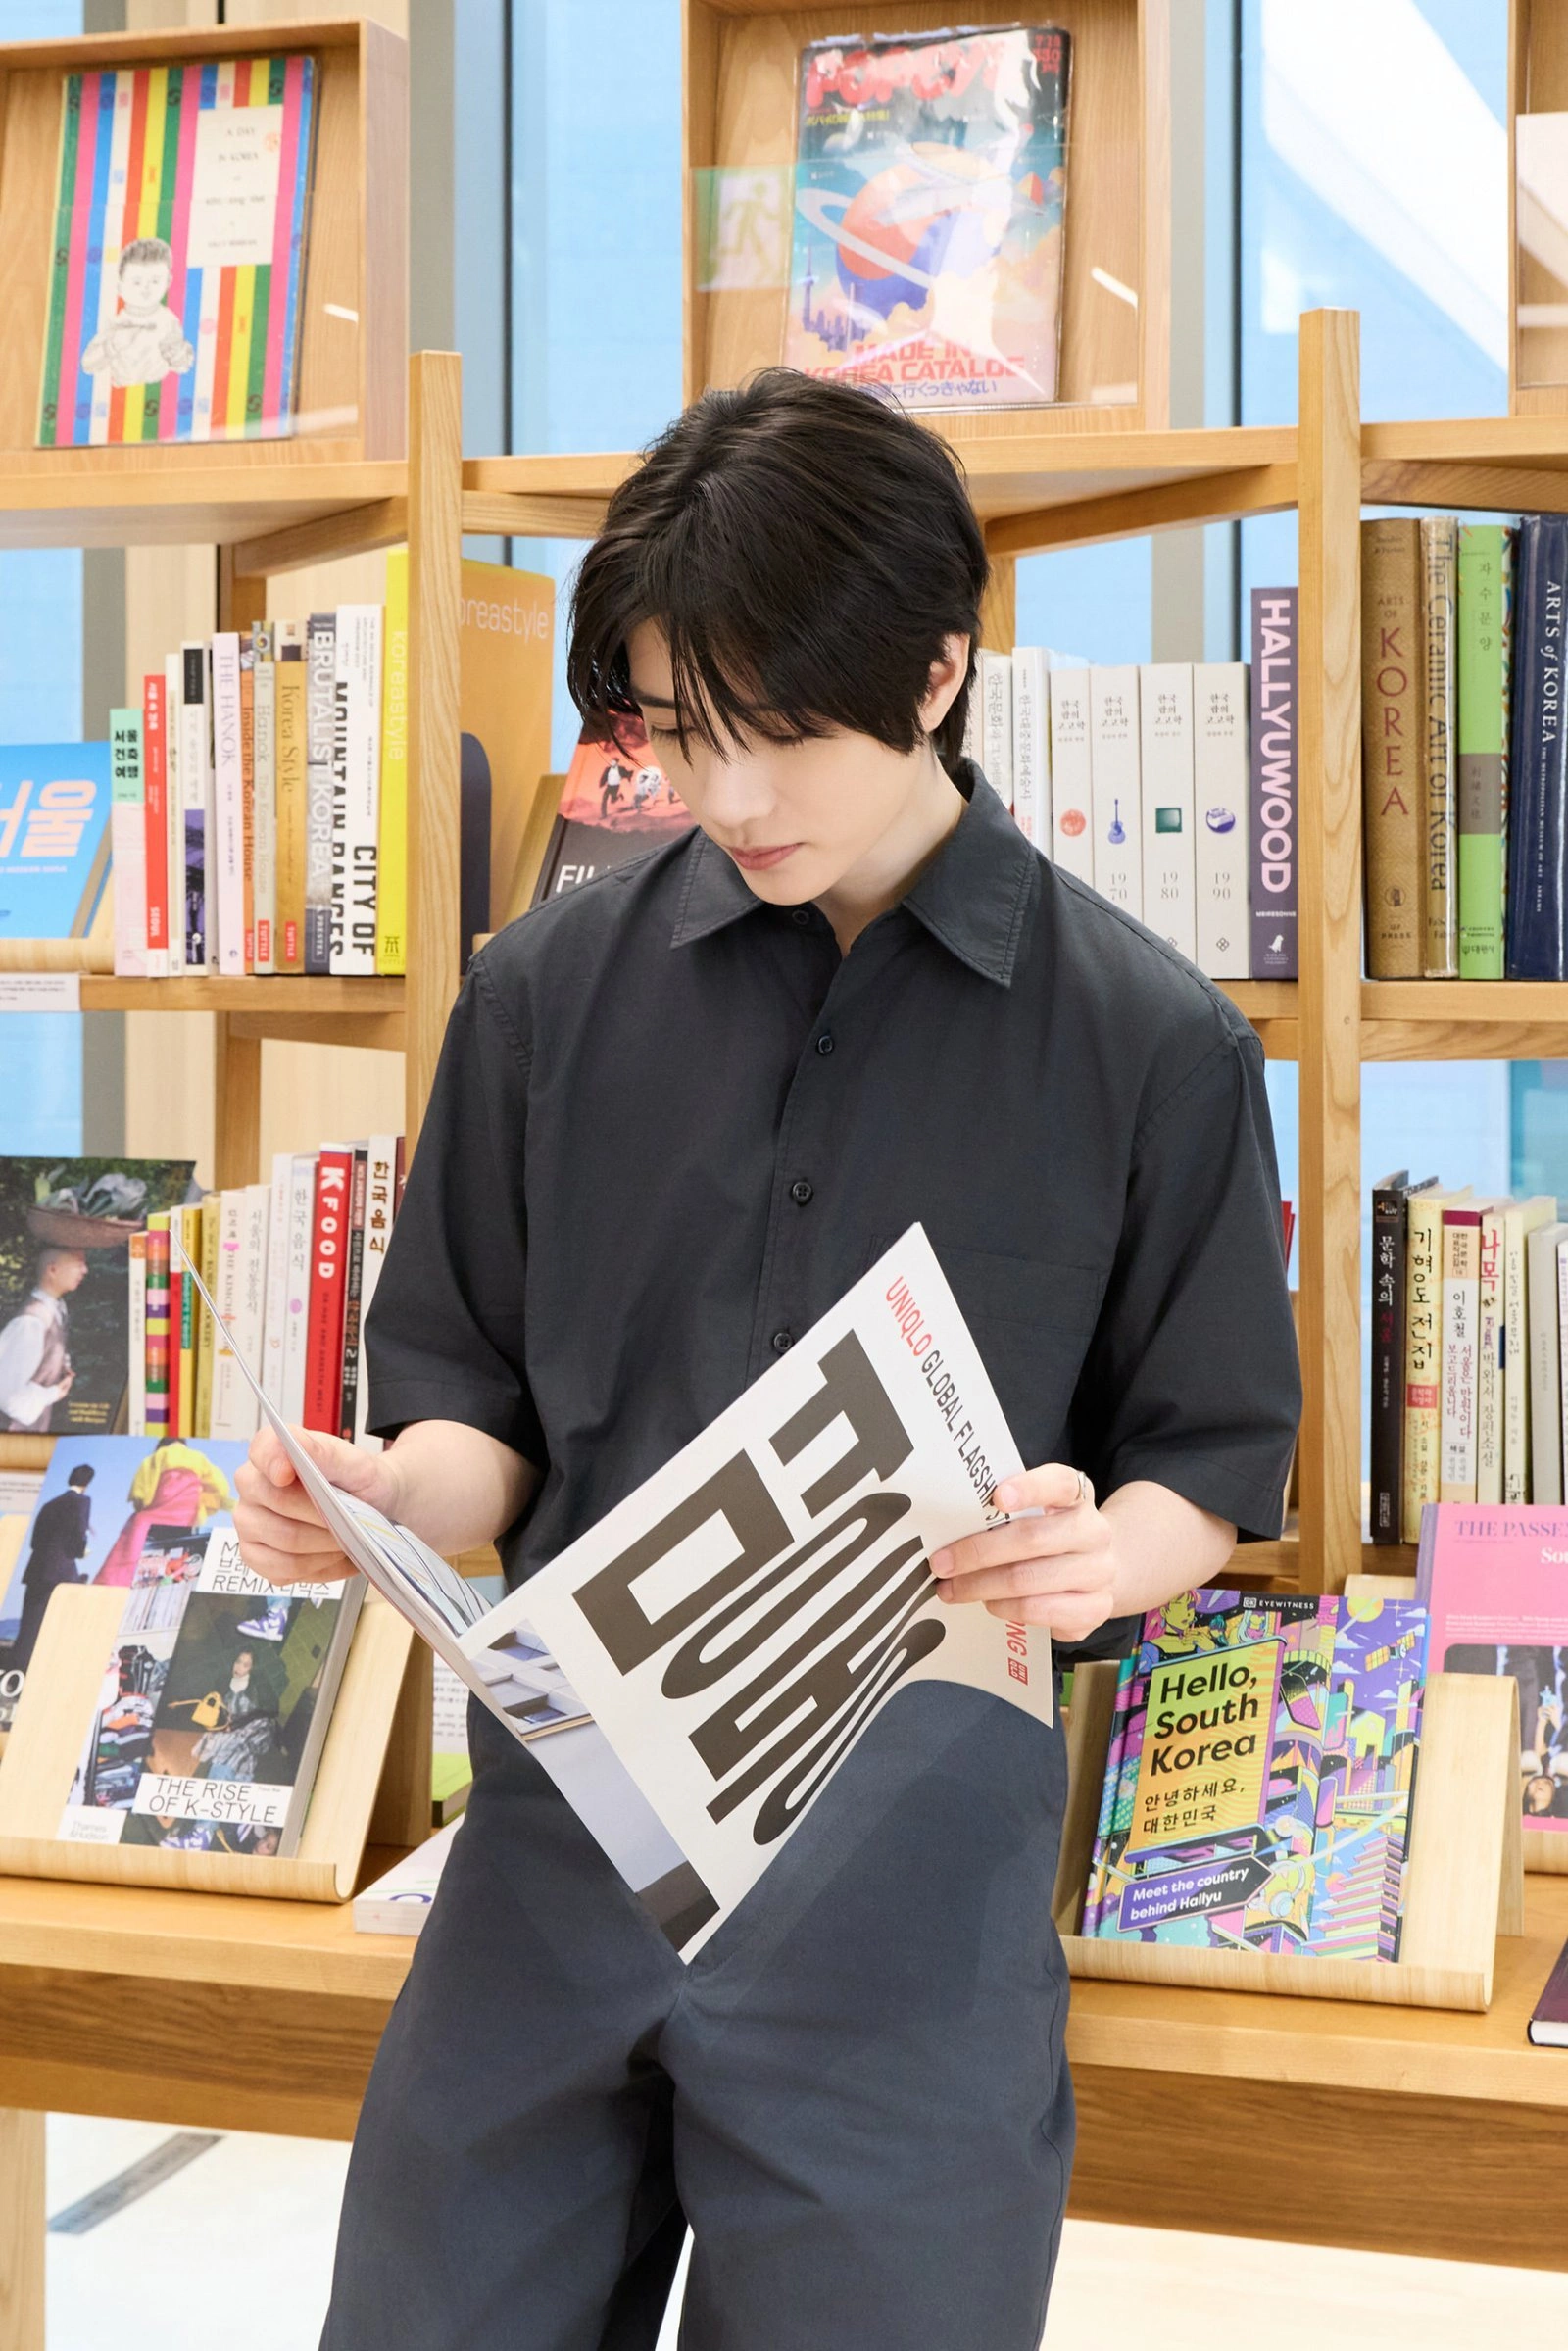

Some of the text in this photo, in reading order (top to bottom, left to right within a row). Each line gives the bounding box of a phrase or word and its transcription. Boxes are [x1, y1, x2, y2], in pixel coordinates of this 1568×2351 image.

[1428, 533, 1453, 586] The
[460, 597, 550, 642] oreastyle
[1428, 594, 1453, 707] Ceramic
[1540, 579, 1562, 744] ARTS of KOREA
[219, 653, 237, 768] THE HANOK
[280, 683, 301, 739] Korea
[387, 630, 407, 761] koreastyle
[115, 729, 138, 743] 서울
[256, 704, 271, 763] Hanok
[1375, 626, 1409, 816] KOREA
[1429, 715, 1453, 763] Art
[115, 747, 139, 760] 건축
[279, 744, 300, 793] Style
[311, 630, 335, 880] BRUTALIST KOREA
[1259, 598, 1292, 894] HALLYUWOOD
[115, 764, 139, 779] 여행
[242, 706, 253, 882] Inside the Korean House
[1429, 811, 1452, 892] Korea
[352, 844, 377, 956] CITY OF
[1109, 889, 1127, 902] 70
[1110, 873, 1127, 885] 19
[1160, 887, 1179, 900] 80
[1162, 871, 1179, 884] 19
[1212, 887, 1231, 900] 90
[1214, 871, 1230, 884] 19
[149, 906, 161, 938] SEOUL
[369, 1160, 389, 1254] 한국음식
[1378, 1235, 1395, 1269] 문학
[1481, 1229, 1500, 1293] 나목
[1378, 1272, 1395, 1306] 속의
[1411, 1227, 1432, 1371] 기형도 전집
[1453, 1290, 1467, 1339] 이호철
[885, 1275, 933, 1358] UNIQLO
[921, 1349, 964, 1433] GLOBAL
[1454, 1520, 1568, 1537] THE PASSE
[1259, 1599, 1315, 1610] EYEWITNESS
[1160, 1664, 1258, 1704] Hello,
[1154, 1692, 1259, 1739] South
[1151, 1732, 1256, 1777] Korea
[148, 1795, 277, 1824] OF K-STYLE
[156, 1776, 252, 1802] THE RISE
[1144, 1776, 1246, 1813] 안녕하세요,
[1143, 1805, 1217, 1835] 대한민국
[1130, 1891, 1223, 1921] behind Hallyu
[1132, 1866, 1250, 1902] Meet the country
